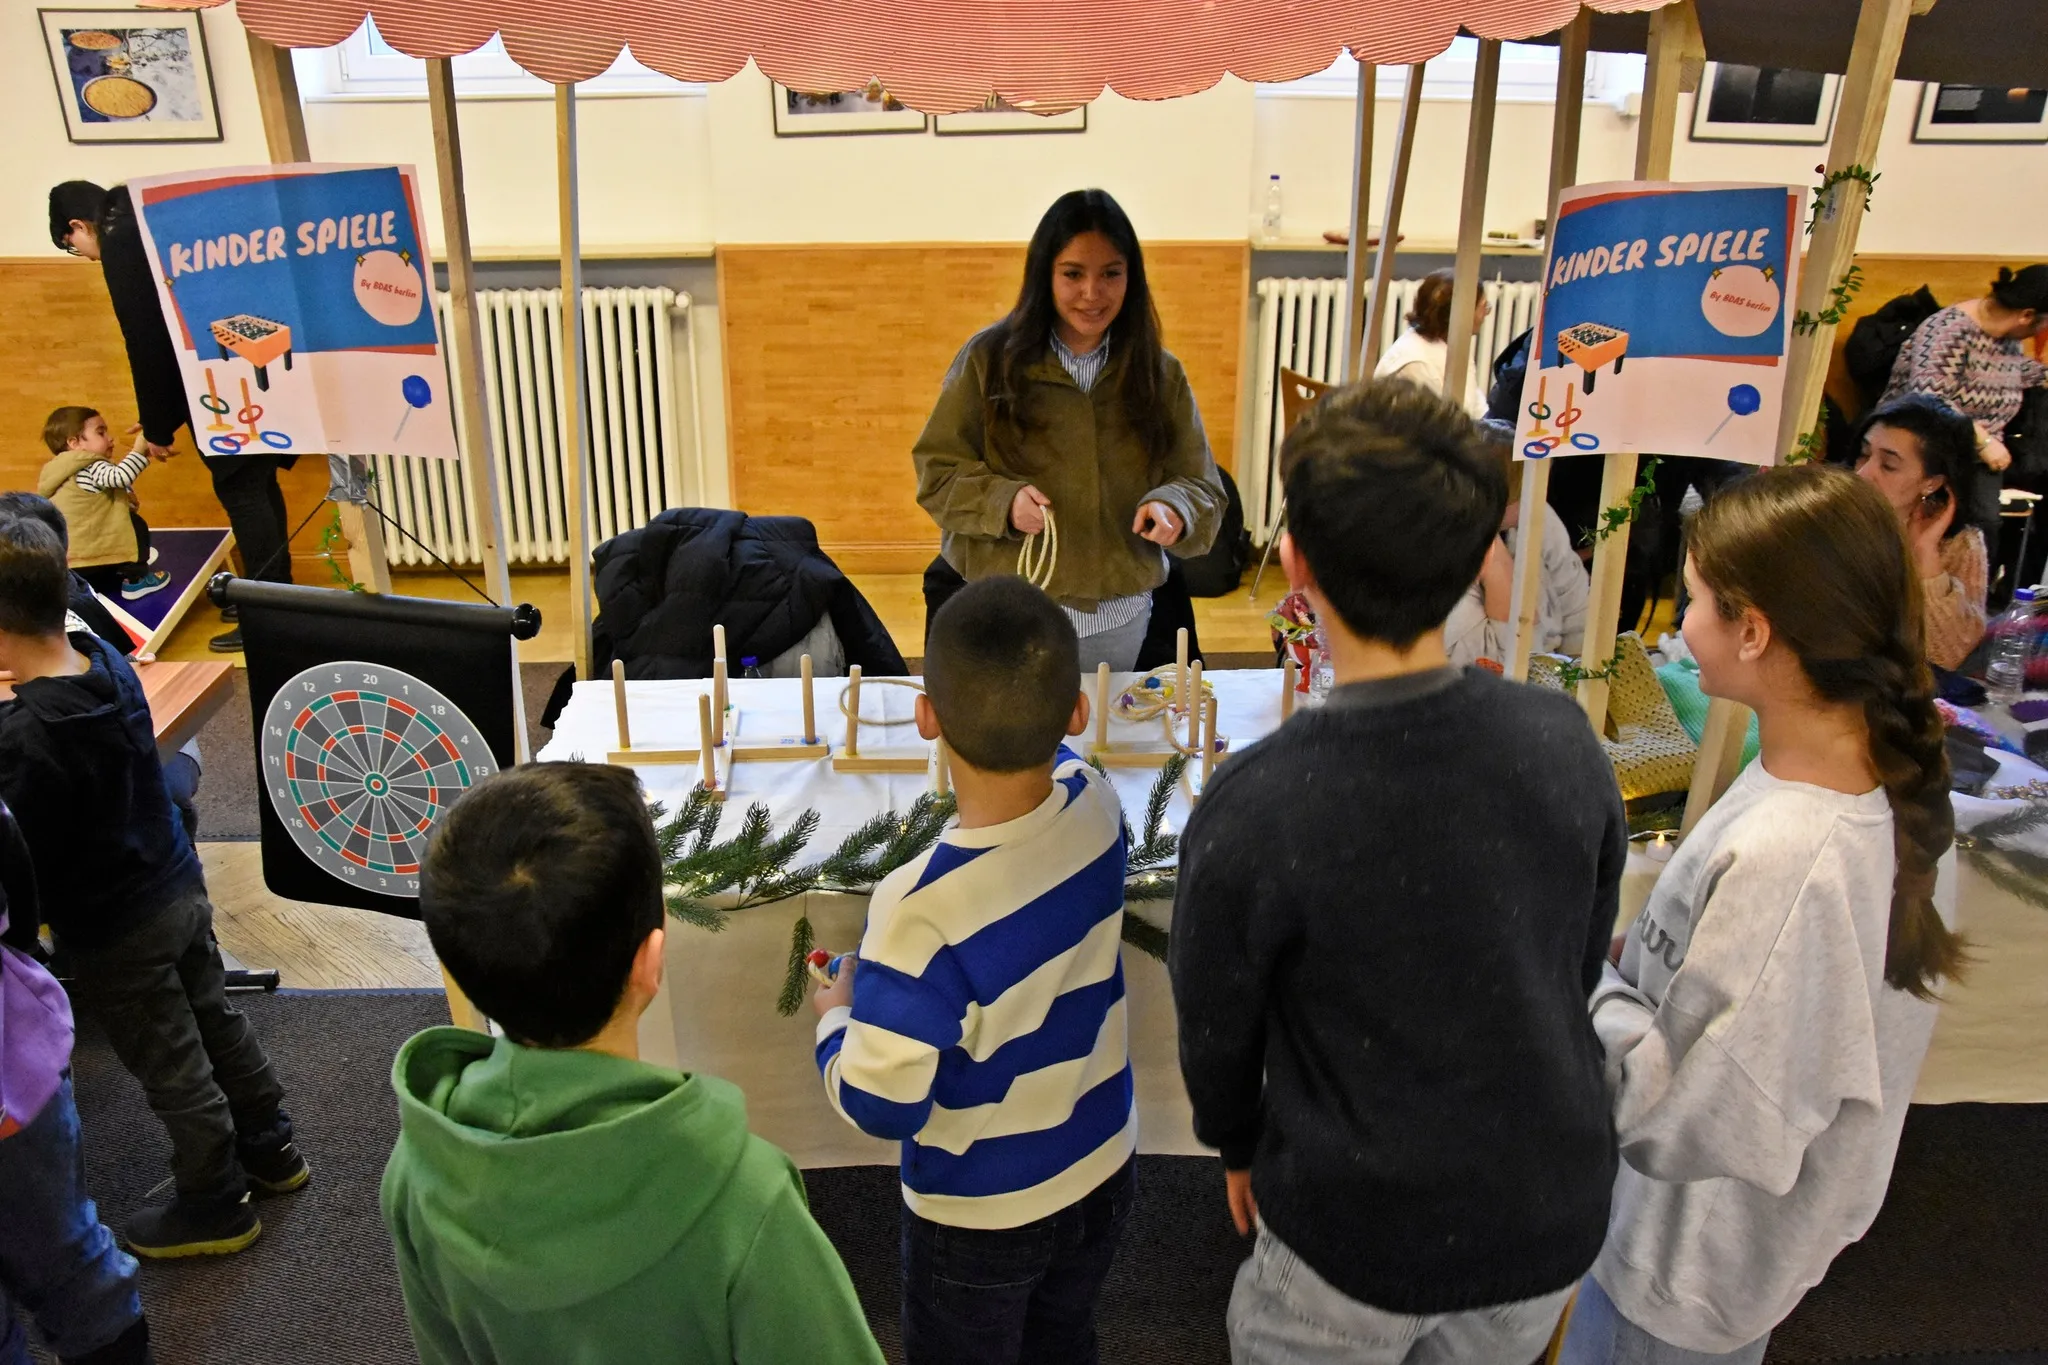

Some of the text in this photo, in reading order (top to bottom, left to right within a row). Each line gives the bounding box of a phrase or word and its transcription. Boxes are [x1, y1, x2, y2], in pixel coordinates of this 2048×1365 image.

[169, 210, 397, 277] KINDER SPIELE
[1550, 228, 1770, 289] KINDER SPIELE
[361, 279, 371, 290] By
[394, 286, 417, 298] berlin
[1710, 291, 1721, 302] By
[1746, 299, 1771, 312] berlin
[334, 674, 342, 683] 5
[363, 674, 378, 685] 20
[302, 682, 316, 693] 12
[403, 685, 409, 695] 1
[284, 701, 292, 710] 9
[431, 705, 446, 716] 18
[270, 726, 282, 737] 14
[461, 735, 469, 745] 4
[269, 756, 280, 766] 11
[474, 766, 489, 776] 13
[278, 789, 286, 798] 8
[290, 818, 303, 829] 16
[316, 846, 323, 855] 7
[342, 866, 356, 876] 19
[380, 878, 387, 887] 3
[407, 880, 420, 890] 17
